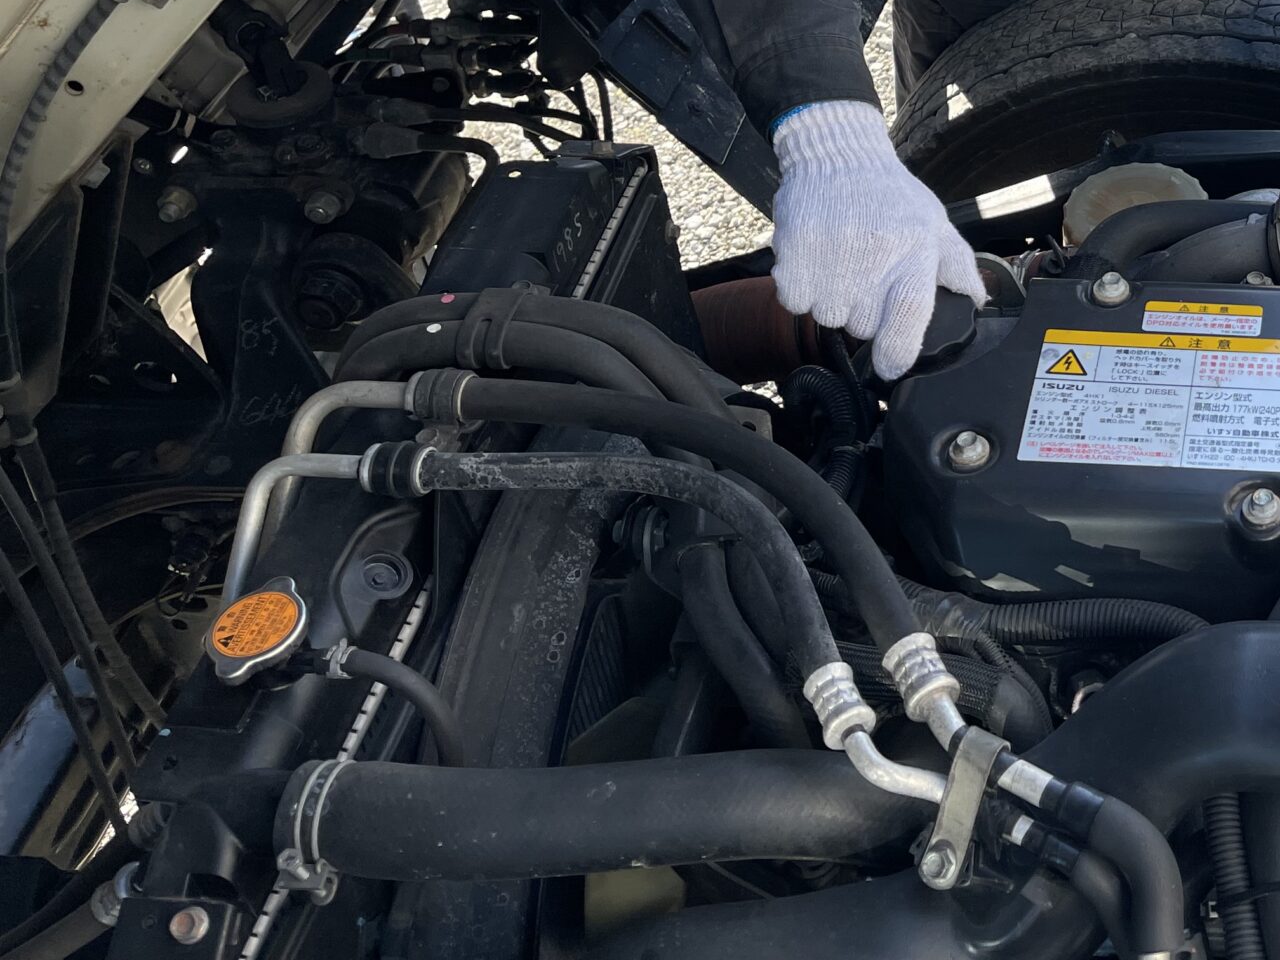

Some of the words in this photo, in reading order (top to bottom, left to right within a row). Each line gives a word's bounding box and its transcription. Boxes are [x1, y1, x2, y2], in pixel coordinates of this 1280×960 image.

[552, 212, 583, 273] 1985
[1188, 338, 1231, 350] 注意
[1042, 382, 1085, 391] ISUZU
[1108, 386, 1140, 394] ISUZU
[1144, 387, 1179, 396] DIESEL
[1194, 391, 1253, 402] エンジン型式
[1193, 402, 1230, 413] 最高出力
[1253, 416, 1280, 427] 電子式
